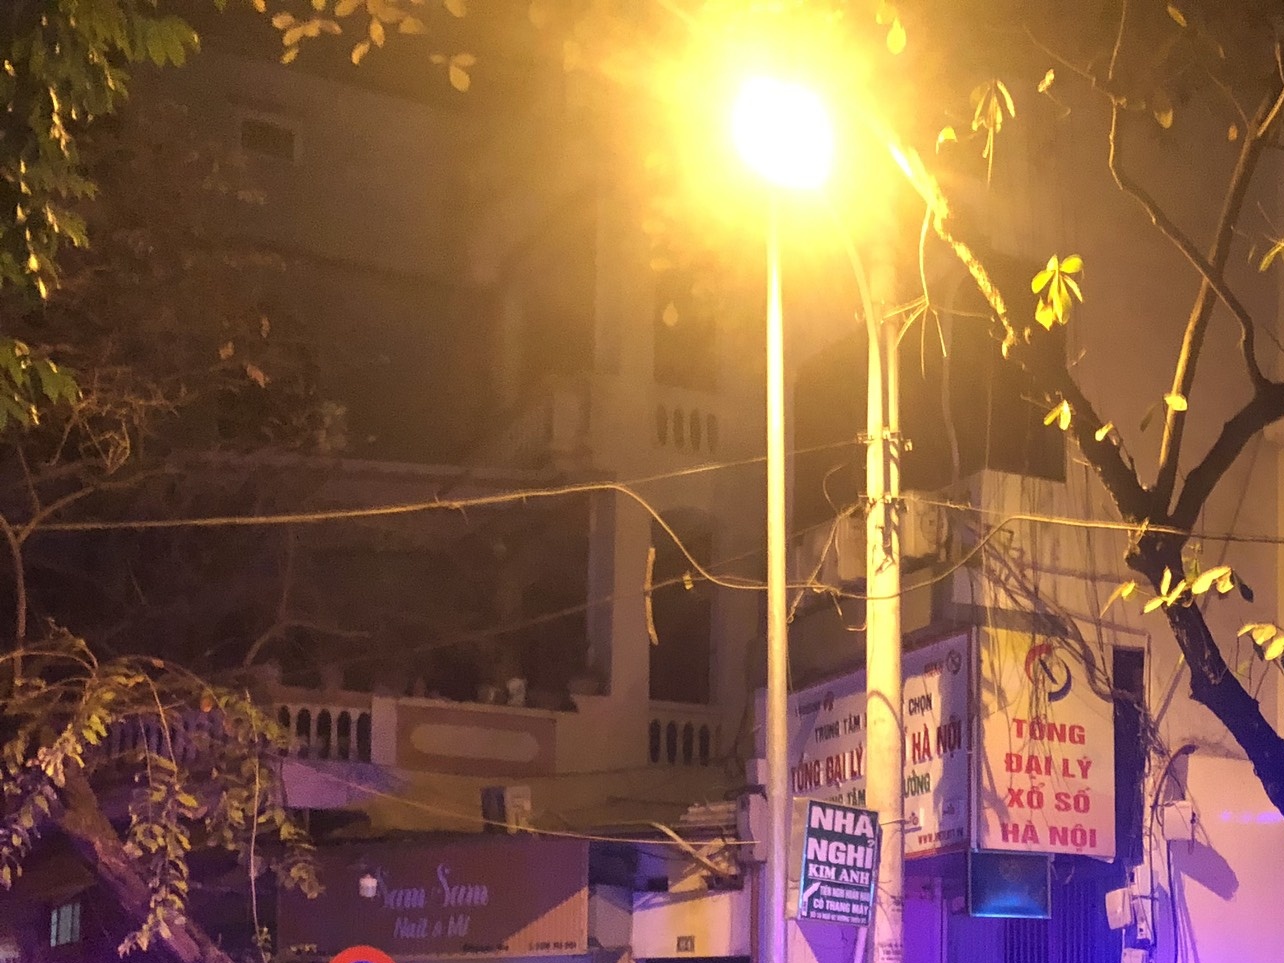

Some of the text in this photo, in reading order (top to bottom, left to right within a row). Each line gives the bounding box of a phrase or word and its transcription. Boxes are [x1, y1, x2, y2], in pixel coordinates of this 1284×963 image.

[912, 715, 962, 765] HÀ NỘI
[1012, 713, 1085, 745] TỔNG
[1004, 752, 1092, 779] ĐẠI LÝ
[1007, 782, 1091, 814] XỔ SỐ
[810, 806, 874, 838] NHÀ
[1000, 820, 1097, 852] HÀ NỘI
[807, 837, 875, 869] NGHỈ
[808, 863, 870, 885] KIM ANH
